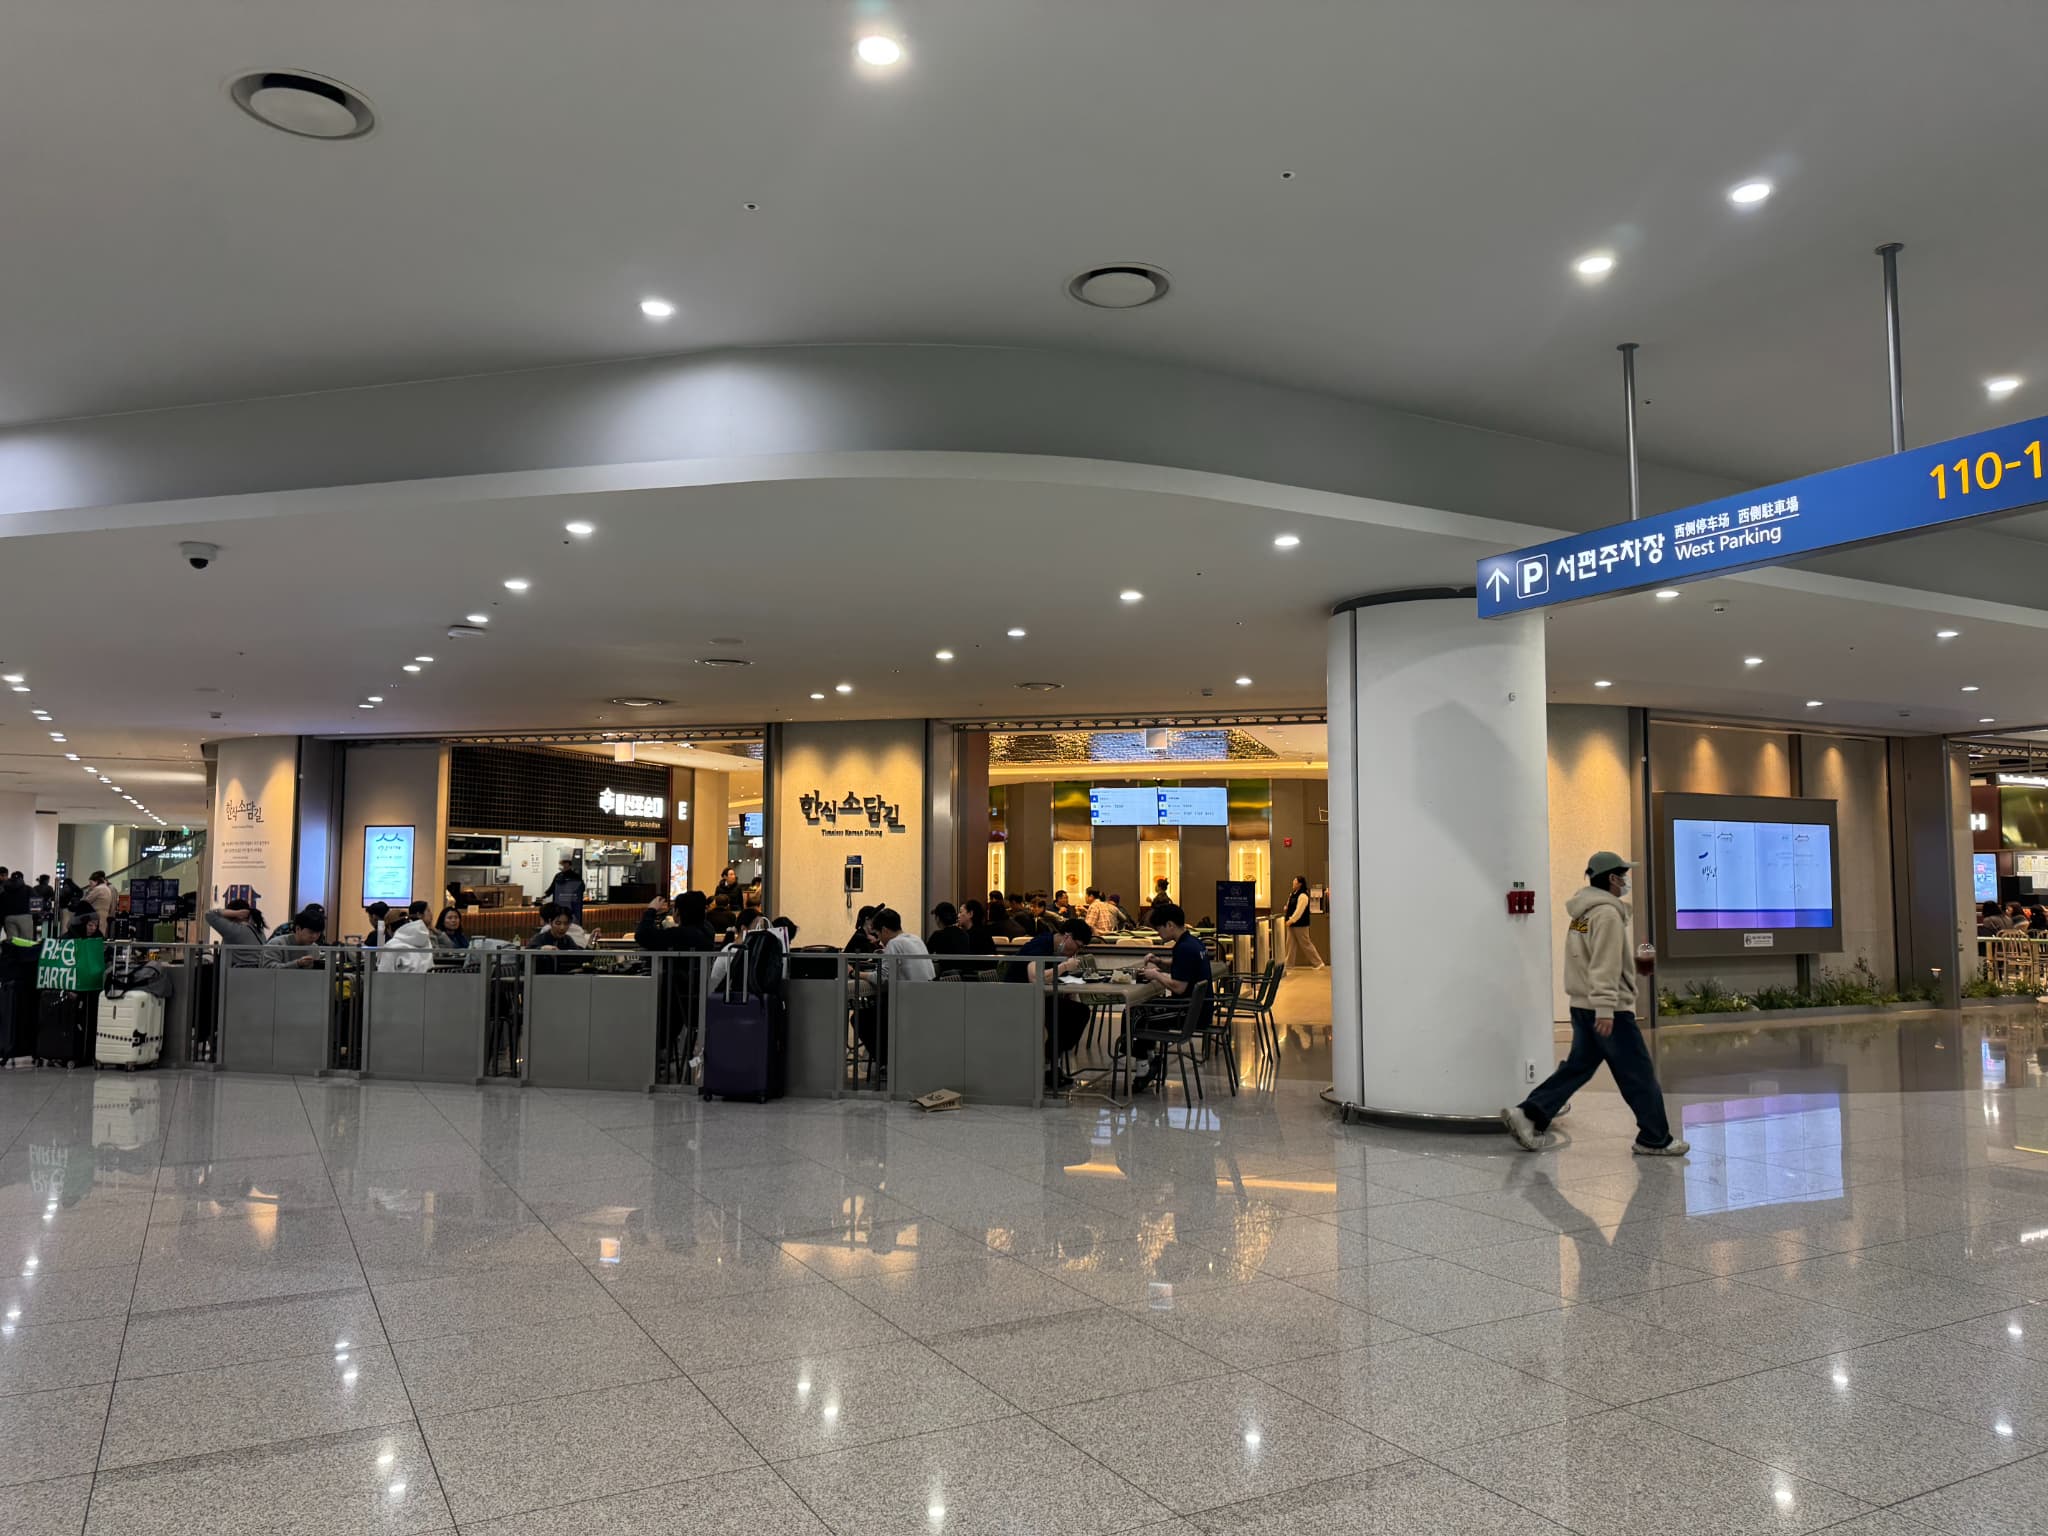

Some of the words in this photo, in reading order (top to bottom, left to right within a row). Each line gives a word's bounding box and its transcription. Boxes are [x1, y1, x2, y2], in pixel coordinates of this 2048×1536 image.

[1929, 440, 2042, 500] 110-1
[1738, 495, 1799, 524] 西側駐車場
[1674, 512, 1730, 539] 西侧停车场
[1674, 539, 1715, 560] West
[1719, 526, 1782, 551] Parking
[1556, 533, 1665, 582] 서편주차장
[1523, 561, 1543, 594] P
[224, 799, 265, 823] 한식소담길
[678, 800, 688, 821] E
[799, 789, 906, 833] 한식소담길
[1970, 813, 1986, 830] H
[864, 829, 883, 838] Dining
[36, 966, 77, 990] EARTH
